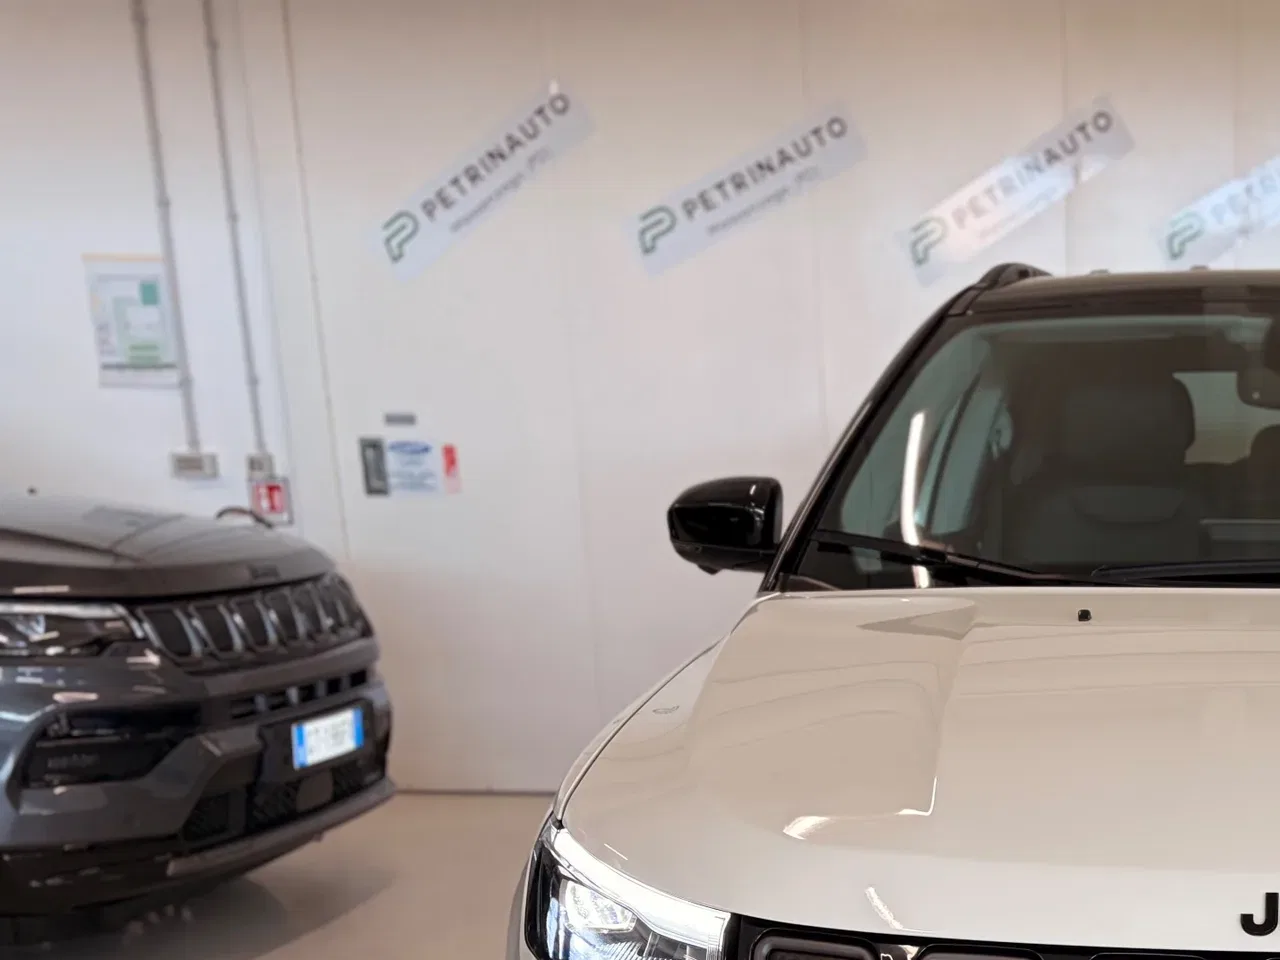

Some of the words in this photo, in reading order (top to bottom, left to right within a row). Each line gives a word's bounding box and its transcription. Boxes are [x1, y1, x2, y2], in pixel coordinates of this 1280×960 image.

[421, 93, 570, 221] PETRINAUTO
[682, 116, 849, 221] PETRINAUTO
[952, 110, 1113, 228] PETRINAUTO
